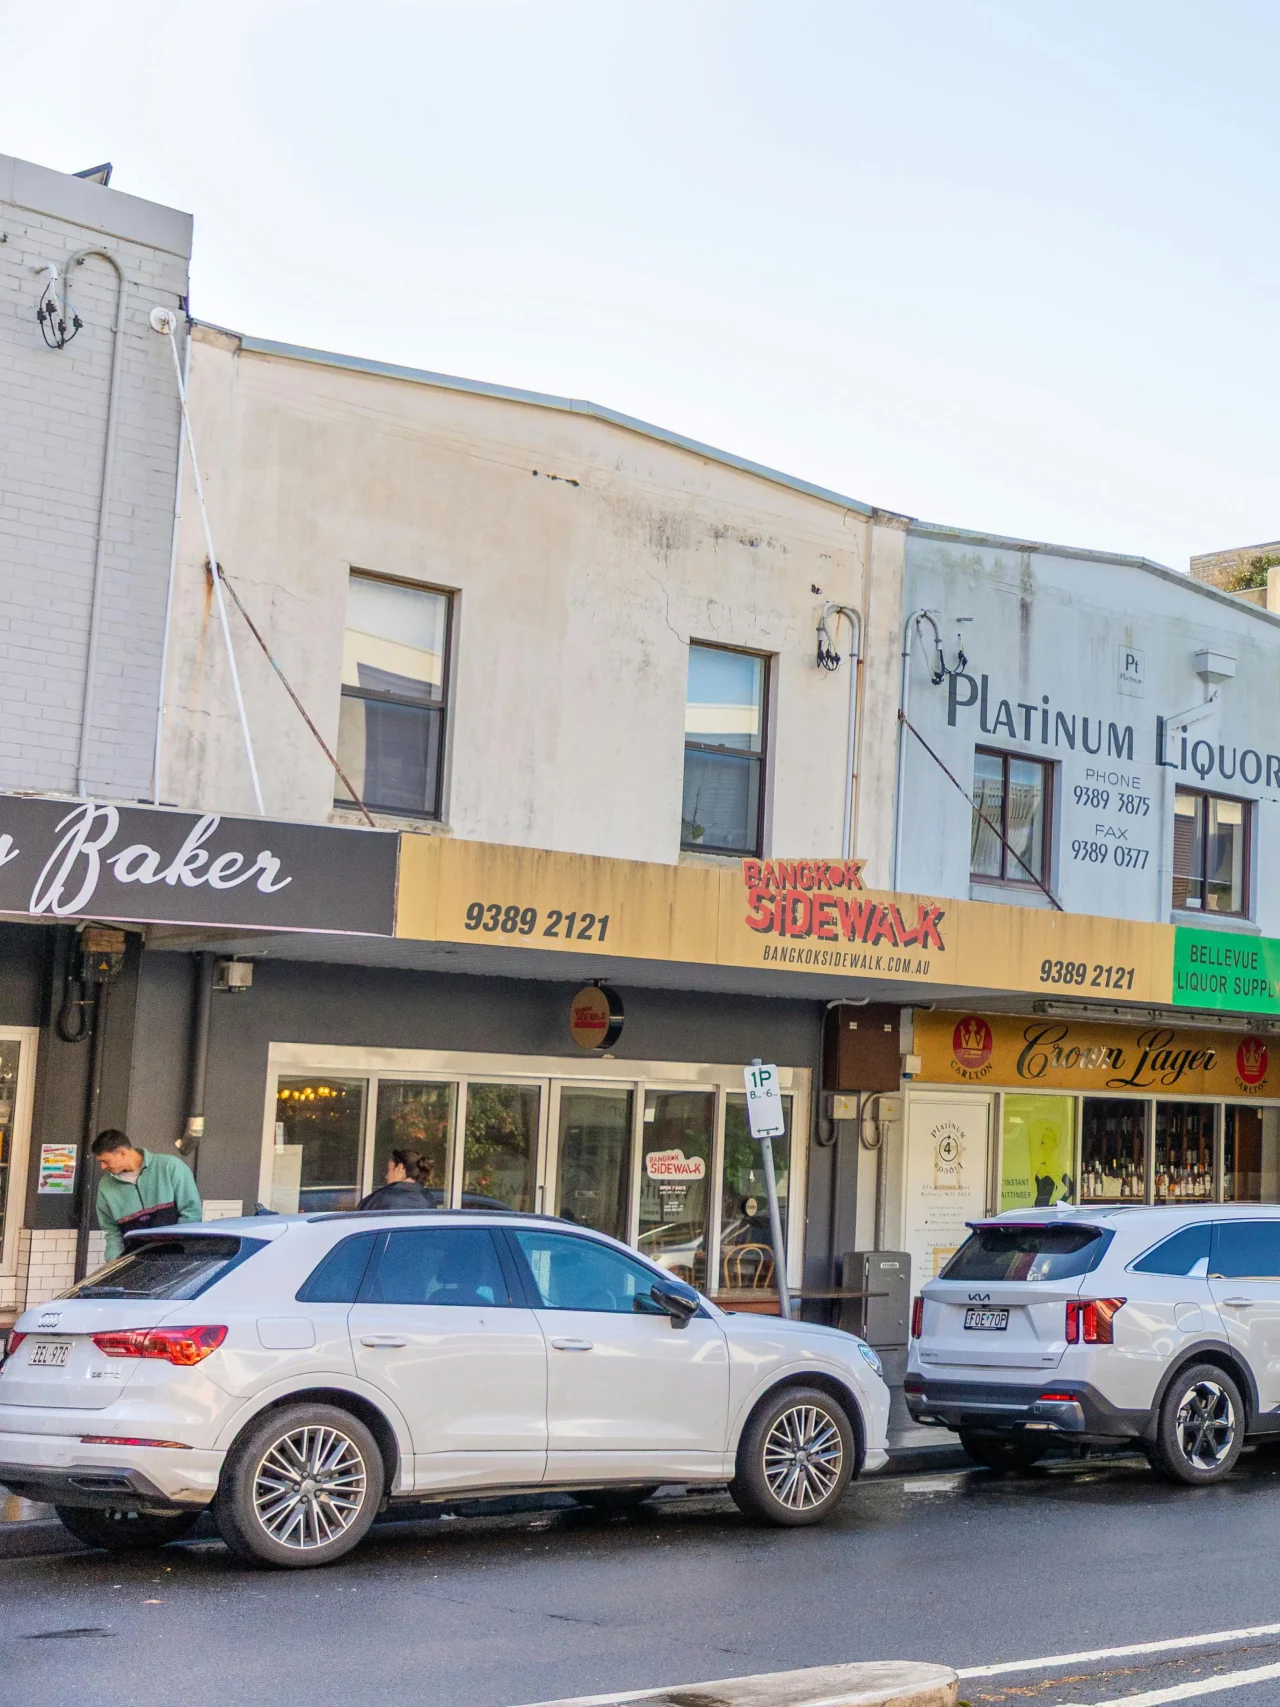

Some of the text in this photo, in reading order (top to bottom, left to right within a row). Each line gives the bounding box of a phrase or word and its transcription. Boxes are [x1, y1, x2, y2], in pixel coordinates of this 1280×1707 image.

[1125, 653, 1139, 673] Pt
[1086, 768, 1141, 789] PHONE
[1073, 785, 1151, 817] 9389 3875
[1095, 824, 1128, 841] FAX
[29, 803, 292, 917] Baker
[1071, 839, 1150, 870] 9389 0377
[743, 860, 863, 891] BANGKOK
[464, 902, 609, 941] 9389 2121
[745, 887, 945, 951] SIDEWALK
[763, 945, 930, 975] BANGKOKSIDEWALK.COM.AU
[1190, 944, 1258, 970] BELLEVUE
[1040, 960, 1135, 989] 9389 2121
[1177, 971, 1280, 998] LIQUOR SUPPLY
[1016, 1023, 1217, 1088] Crown Lager
[751, 1070, 771, 1088] 1P
[950, 1060, 993, 1080] CARLTON
[1234, 1076, 1268, 1094] CARLTON
[931, 1120, 965, 1139] PLATINUM
[650, 1154, 679, 1163] BANGKOK
[944, 1142, 951, 1155] 4
[650, 1162, 701, 1174] SIDEWALK
